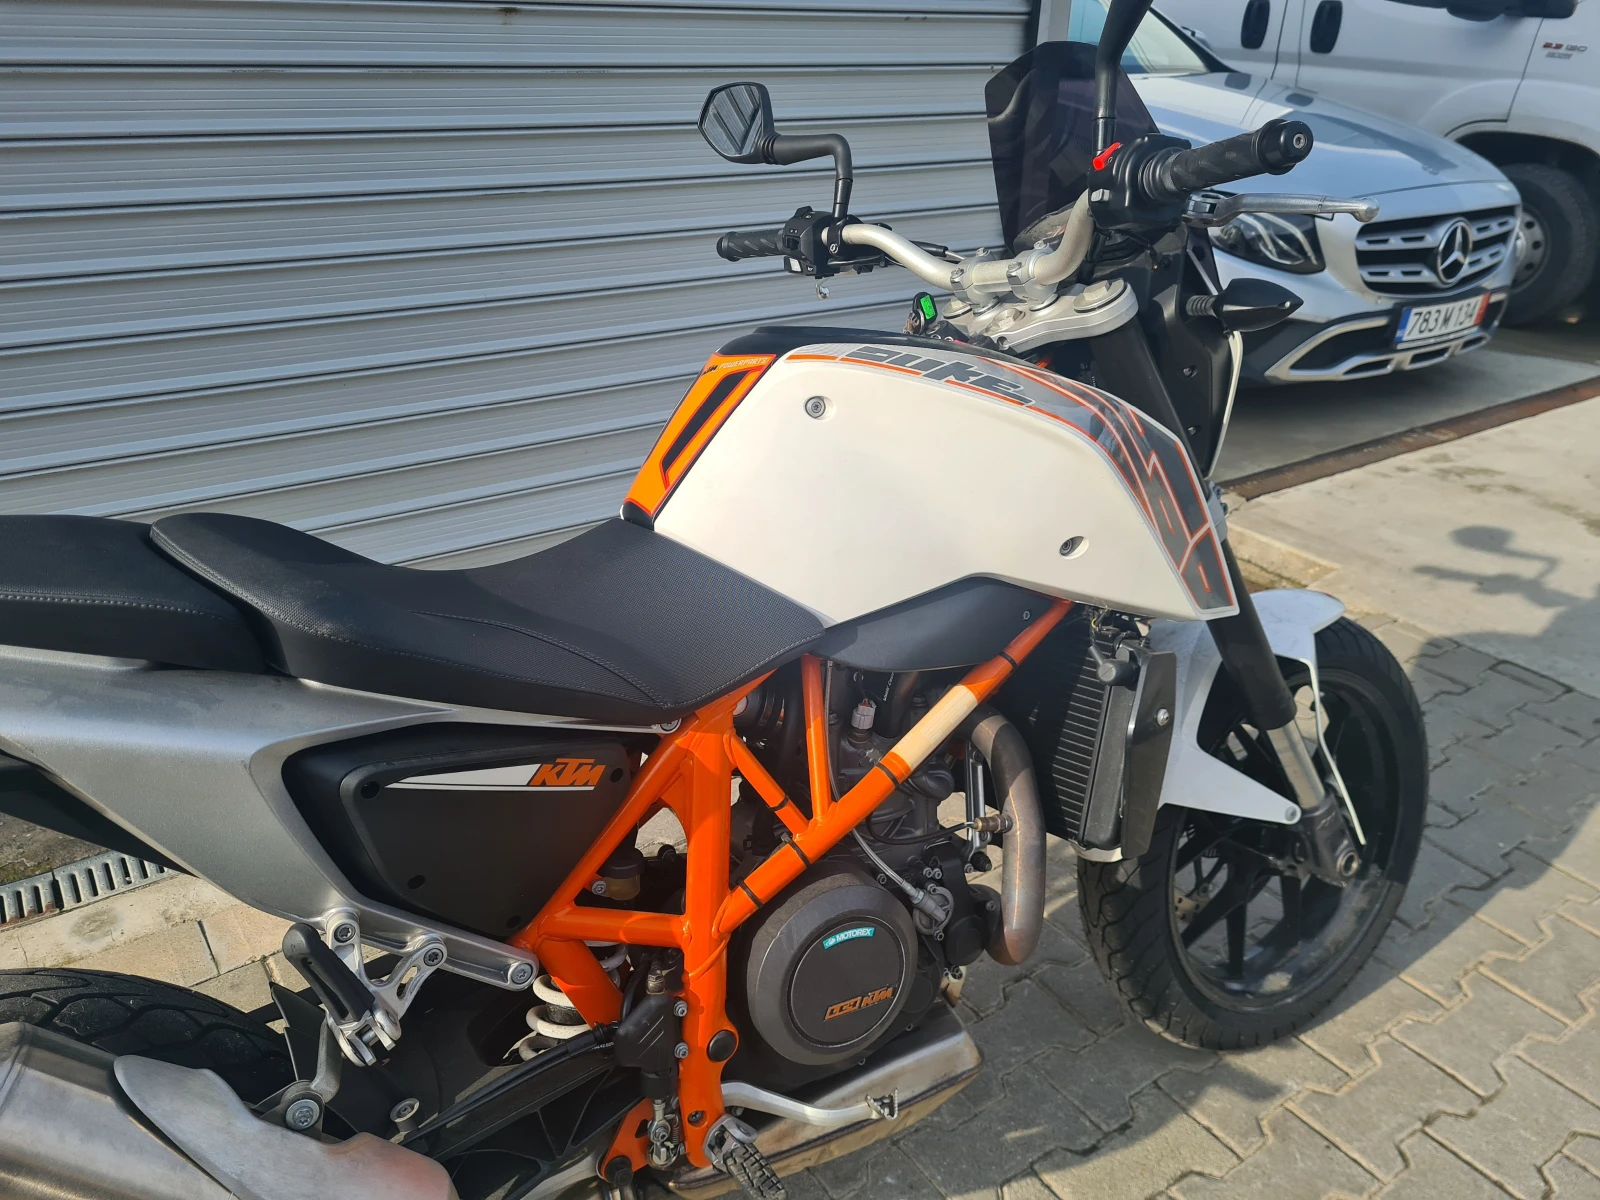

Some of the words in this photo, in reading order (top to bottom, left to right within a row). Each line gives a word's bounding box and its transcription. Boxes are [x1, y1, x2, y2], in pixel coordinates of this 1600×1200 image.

[1408, 310, 1441, 336] 783
[1454, 301, 1478, 327] 134
[720, 357, 768, 370] POWERPARTS
[845, 345, 1035, 407] DUKE
[529, 758, 606, 786] KTM
[836, 928, 872, 942] MOTOREX
[861, 987, 893, 1008] KTM
